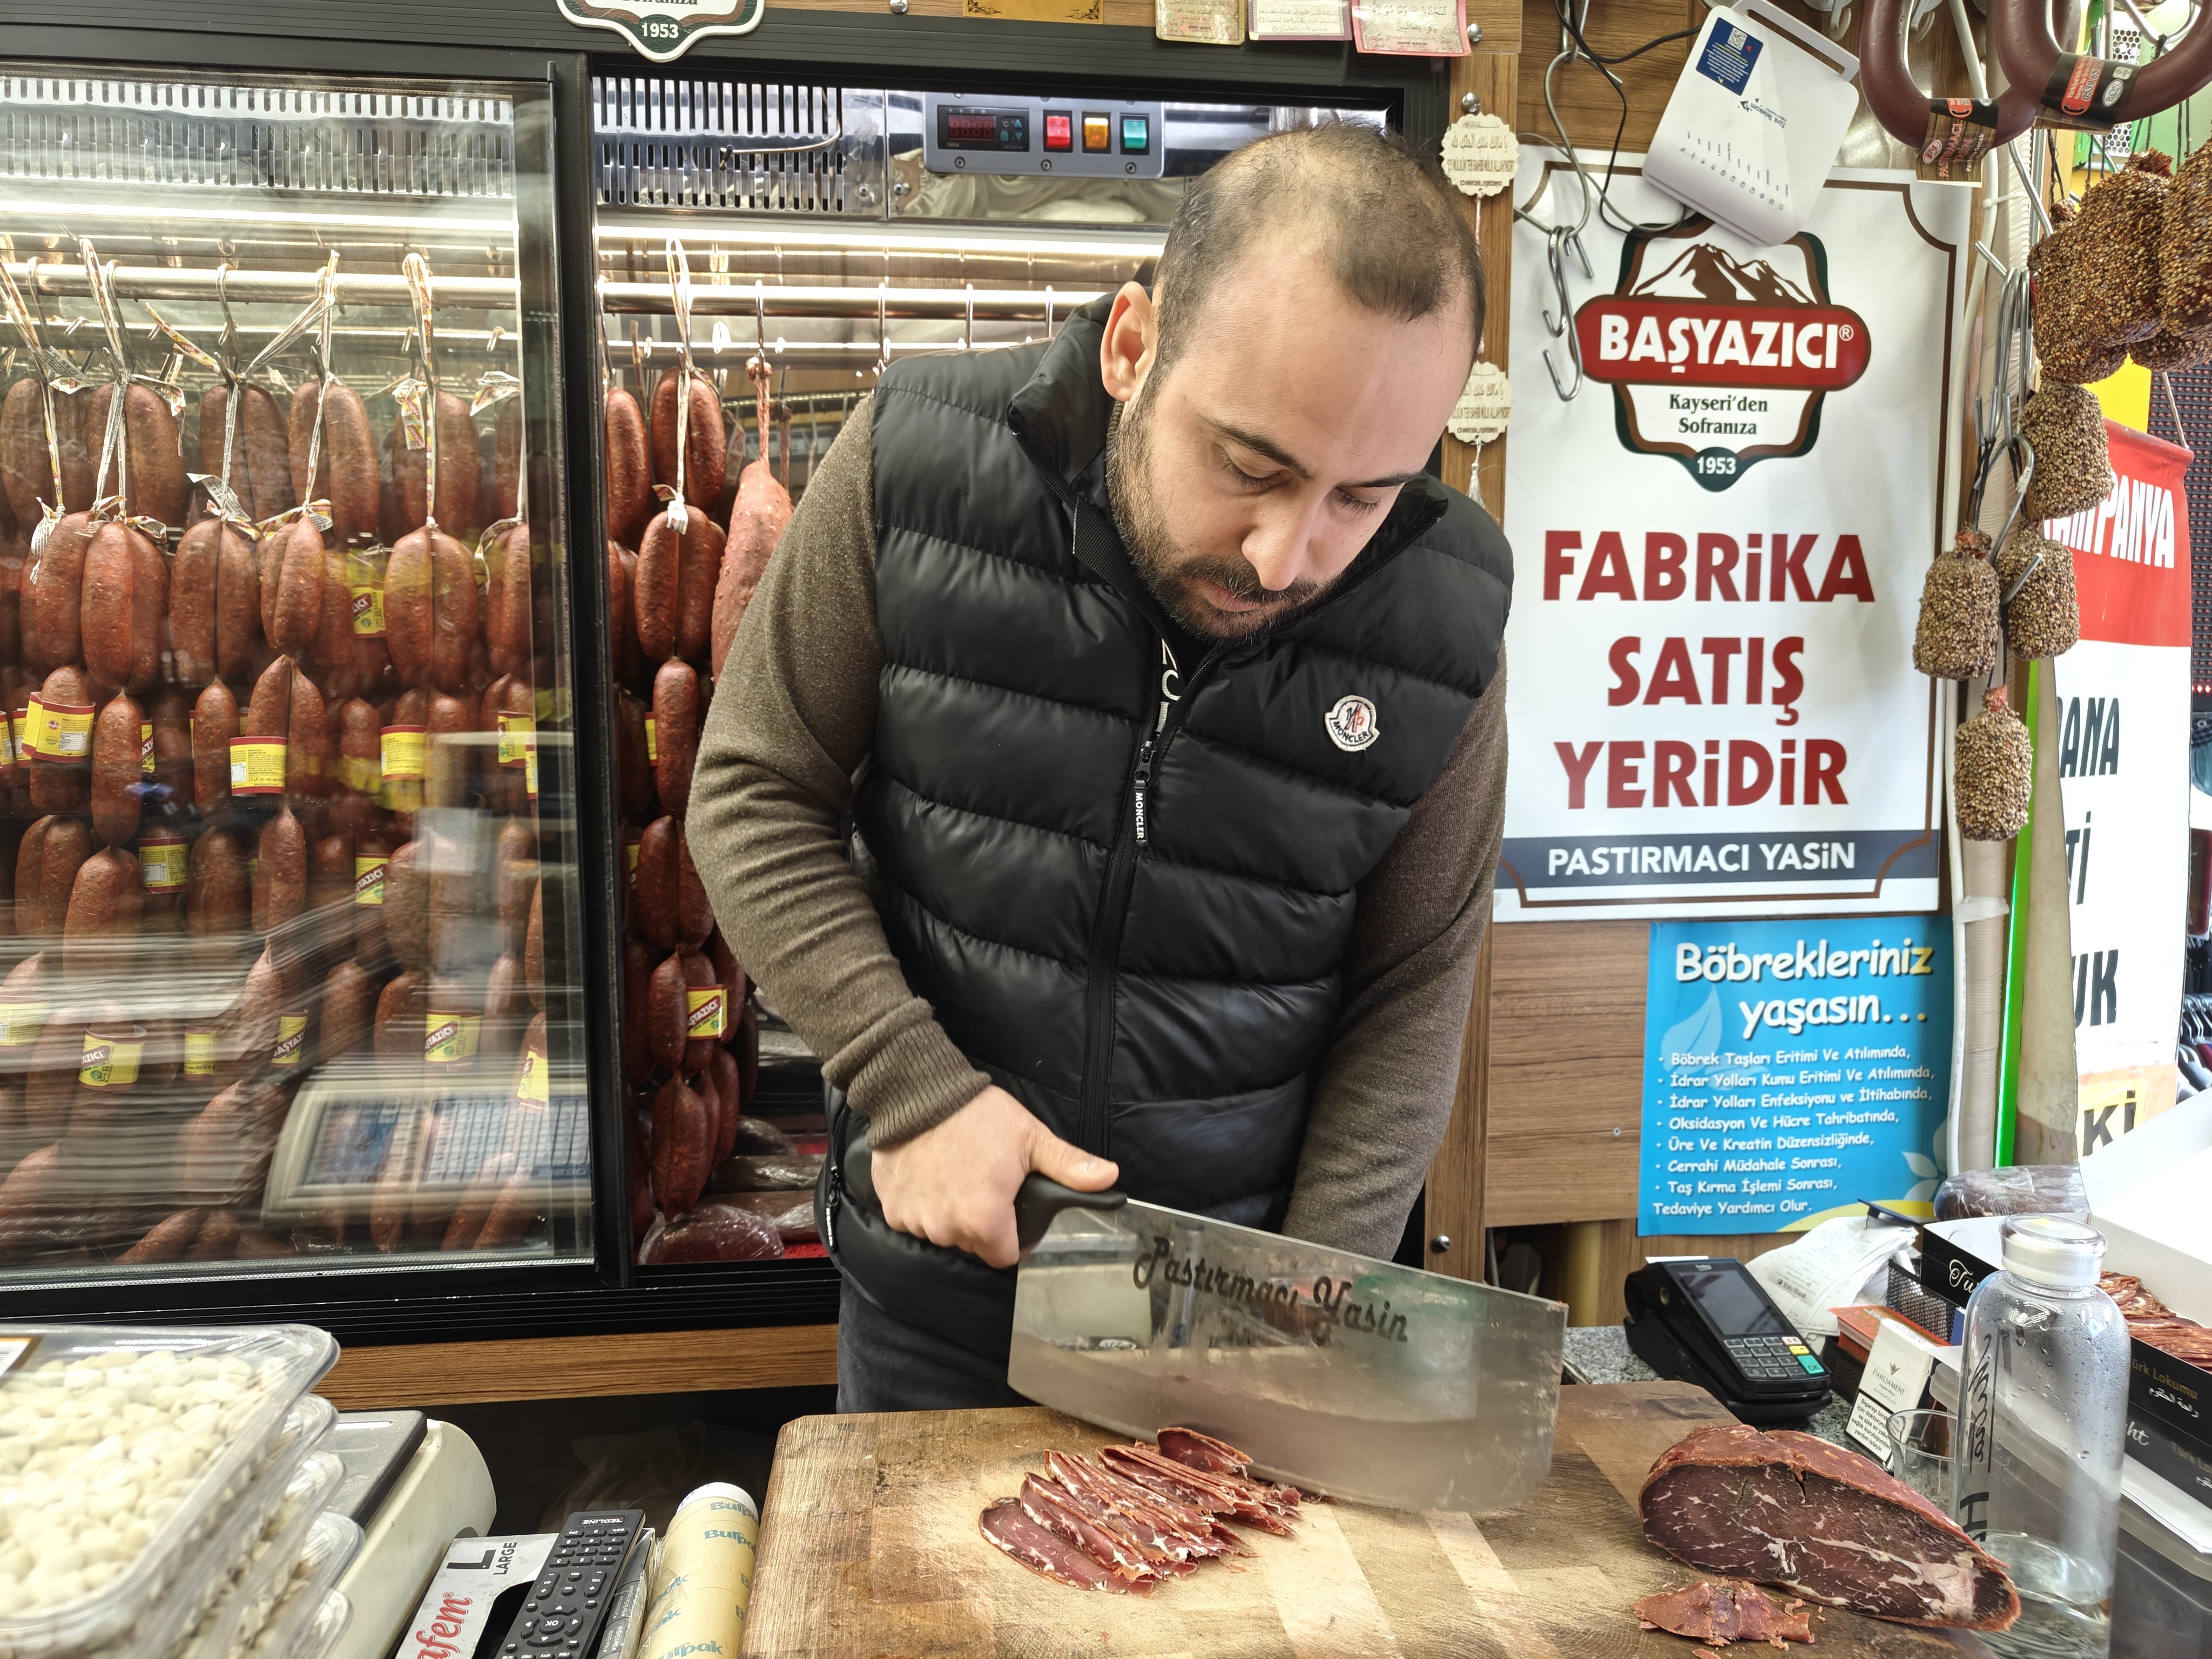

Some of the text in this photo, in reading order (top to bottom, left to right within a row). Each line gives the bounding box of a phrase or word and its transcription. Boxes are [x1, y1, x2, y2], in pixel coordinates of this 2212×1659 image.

[642, 23, 679, 38] 1953
[1669, 394, 1769, 413] Kayseri'den
[1678, 417, 1757, 435] Sofranıza
[1696, 457, 1737, 475] 1953
[1607, 636, 1805, 727] SATIŞ
[1332, 720, 1370, 743] MONCLER
[1135, 792, 1144, 840] MONCLER
[1548, 845, 1750, 875] PASTIRMACI
[1676, 938, 1933, 983] Böbrekleriniz
[1671, 1046, 1911, 1069] Böbrek Taşları Eritimi Ve Atılımında,
[1670, 1066, 1934, 1087] İdrar Yolları Kumu Eritimi Ve Atılımında,
[1670, 1085, 1932, 1109] İdrar Yolları Enfeksiyonu ve İltihabında,
[1669, 1110, 1900, 1134] Oksidasyon Ve Hücre Tahribatında,
[1668, 1131, 1874, 1152] Üre Ve Kreatin Düzensizliğinde,
[1667, 1156, 1842, 1173] Cerrahi Müdahale Sonrası,
[1667, 1177, 1837, 1197] Taş Kırma İşlemi Sonrası,
[1653, 1199, 1812, 1218] Tedaviye Yardımcı Olur.
[1313, 1276, 1410, 1344] Yasin
[1808, 1364, 1819, 1372] OK
[1872, 1368, 1905, 1396] PARLIAMENT
[2132, 1358, 2198, 1400] ürk Lokumu
[1856, 1405, 1865, 1414] için
[1860, 1398, 1878, 1413] Sigarayı
[1863, 1415, 1872, 1426] size
[1851, 1417, 1891, 1450] sağlık kuruluşundan
[1854, 1428, 1883, 1453] yardım isteyin
[446, 1549, 497, 1569] L
[493, 1542, 518, 1575] LARGE
[659, 1640, 723, 1659] urpak
